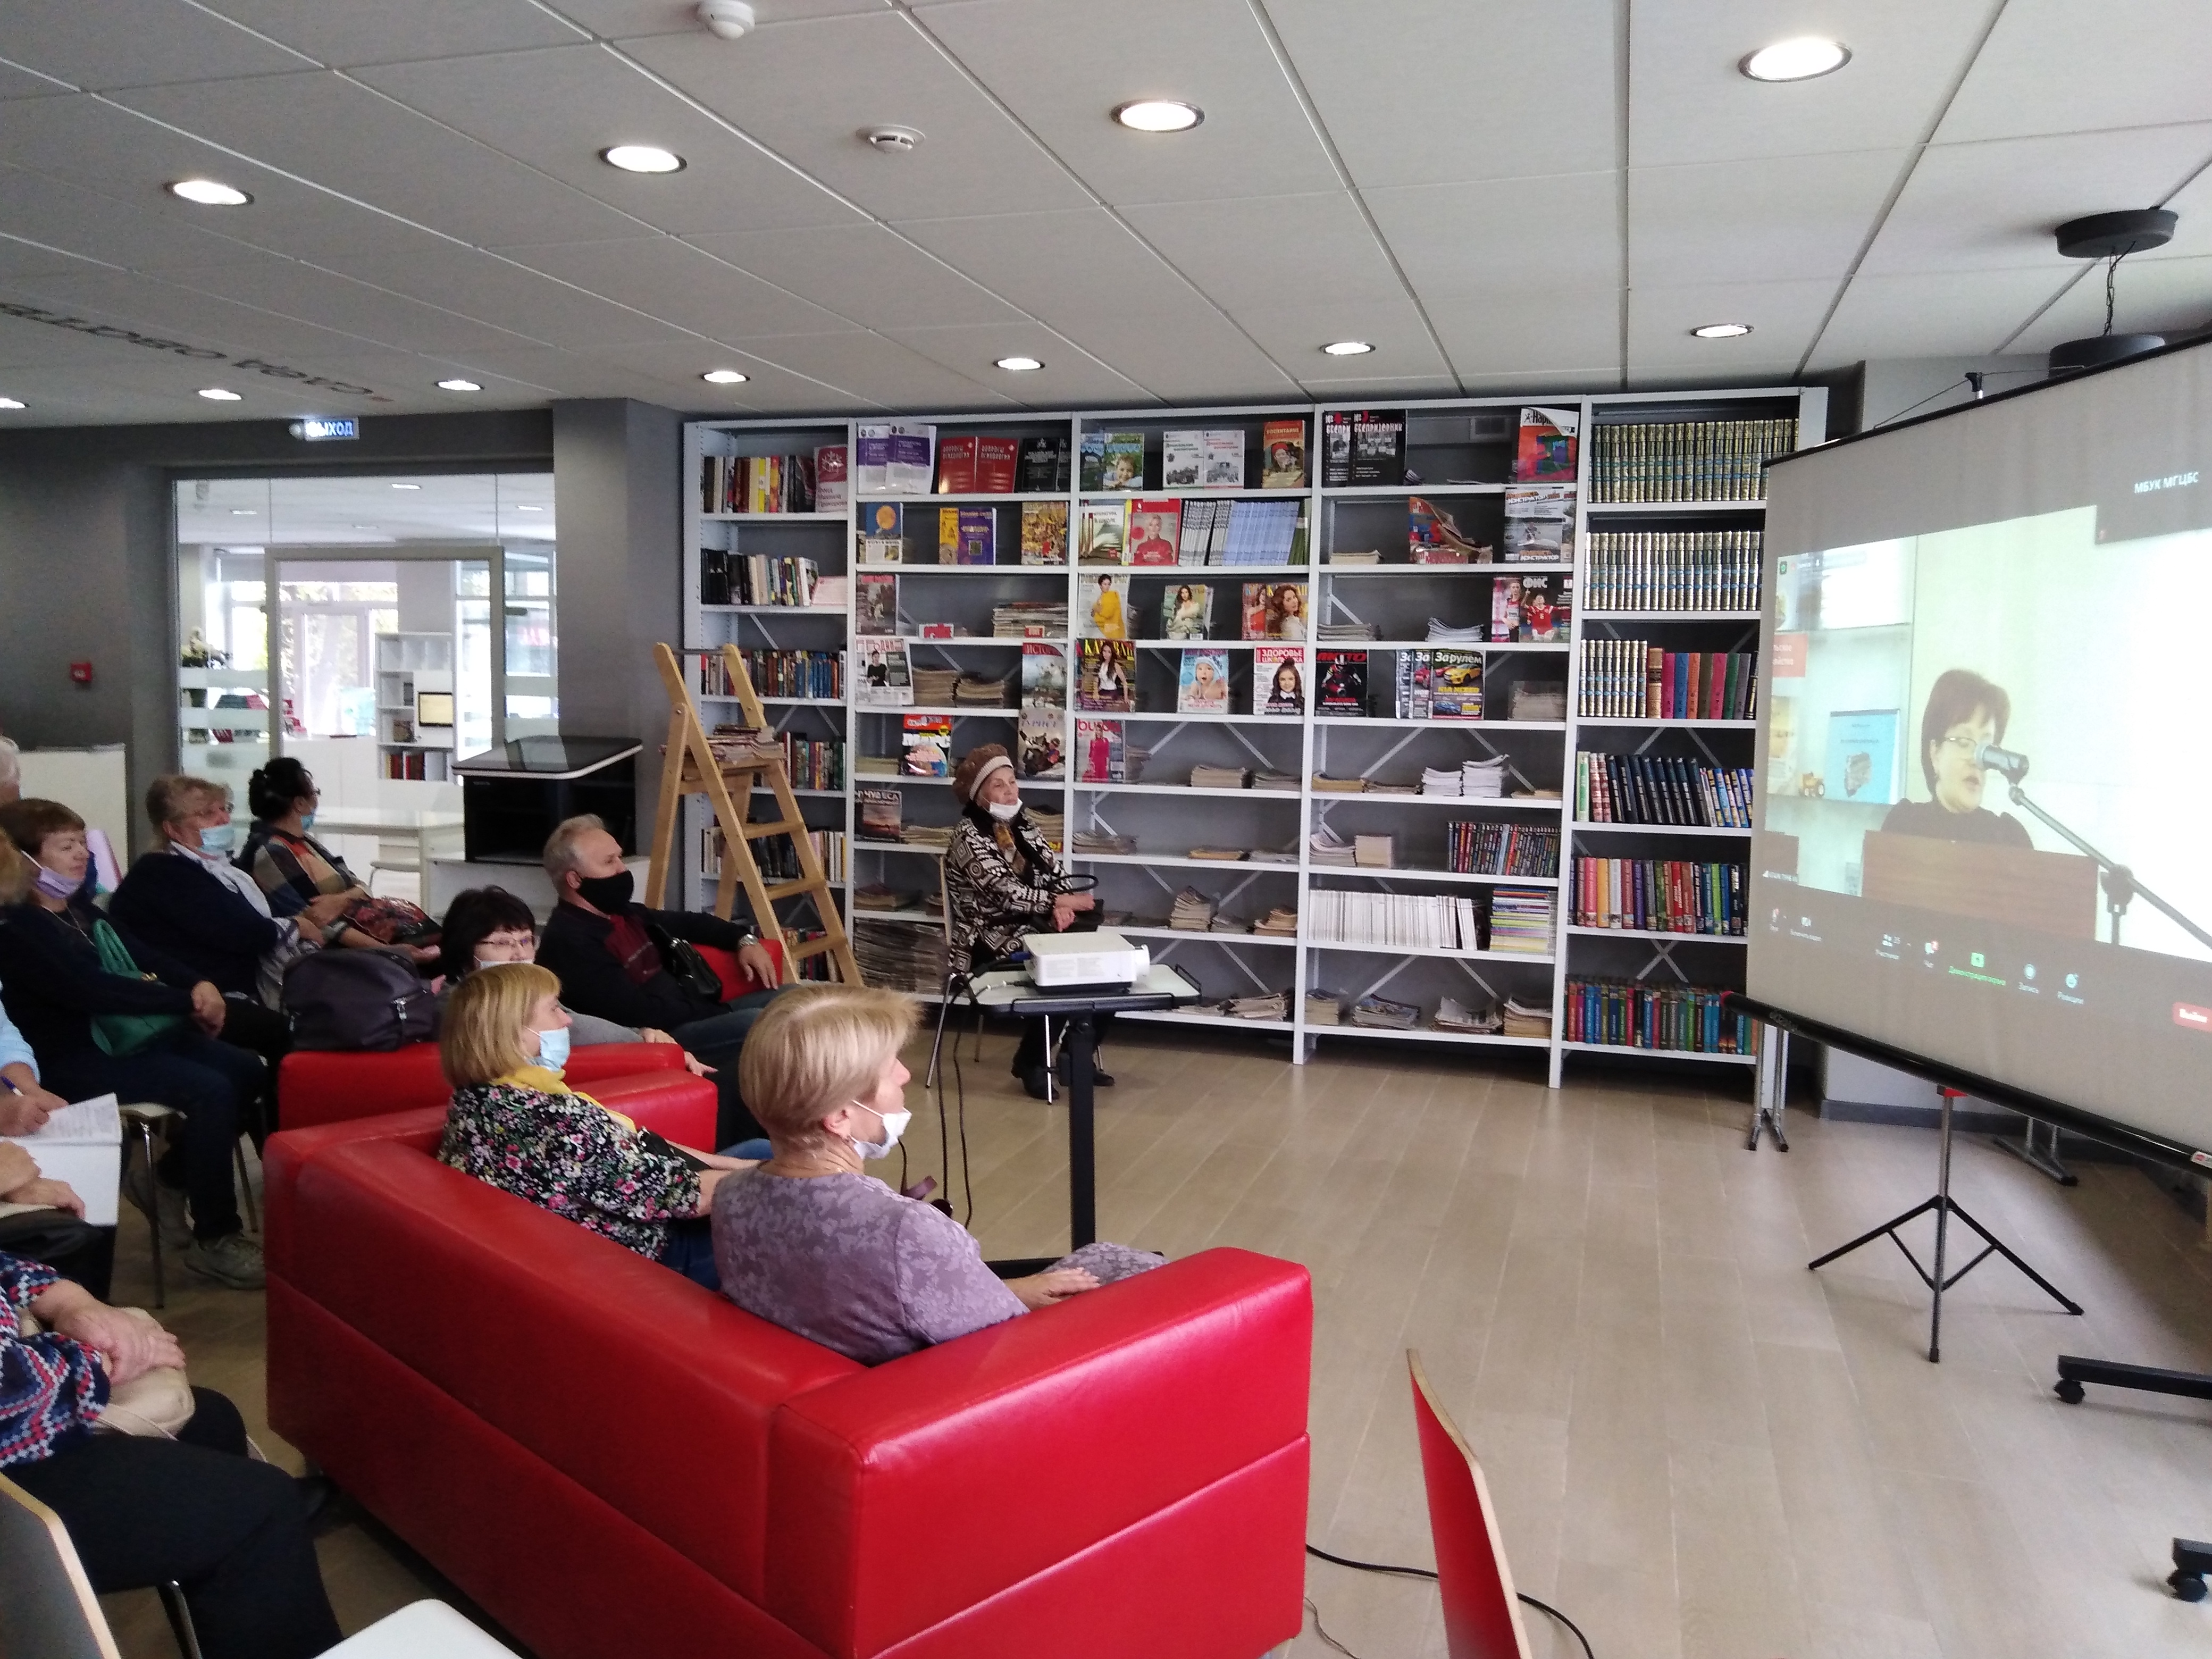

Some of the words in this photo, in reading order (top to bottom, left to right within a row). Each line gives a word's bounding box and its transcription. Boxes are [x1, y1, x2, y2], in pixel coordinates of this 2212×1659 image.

[305, 421, 354, 437] ЫХОД
[2134, 480, 2160, 493] МБУК
[2163, 472, 2199, 489] МГЦБС
[1085, 639, 1134, 657] КАВАН
[1262, 649, 1303, 657] ЗДОРОВЬЕ
